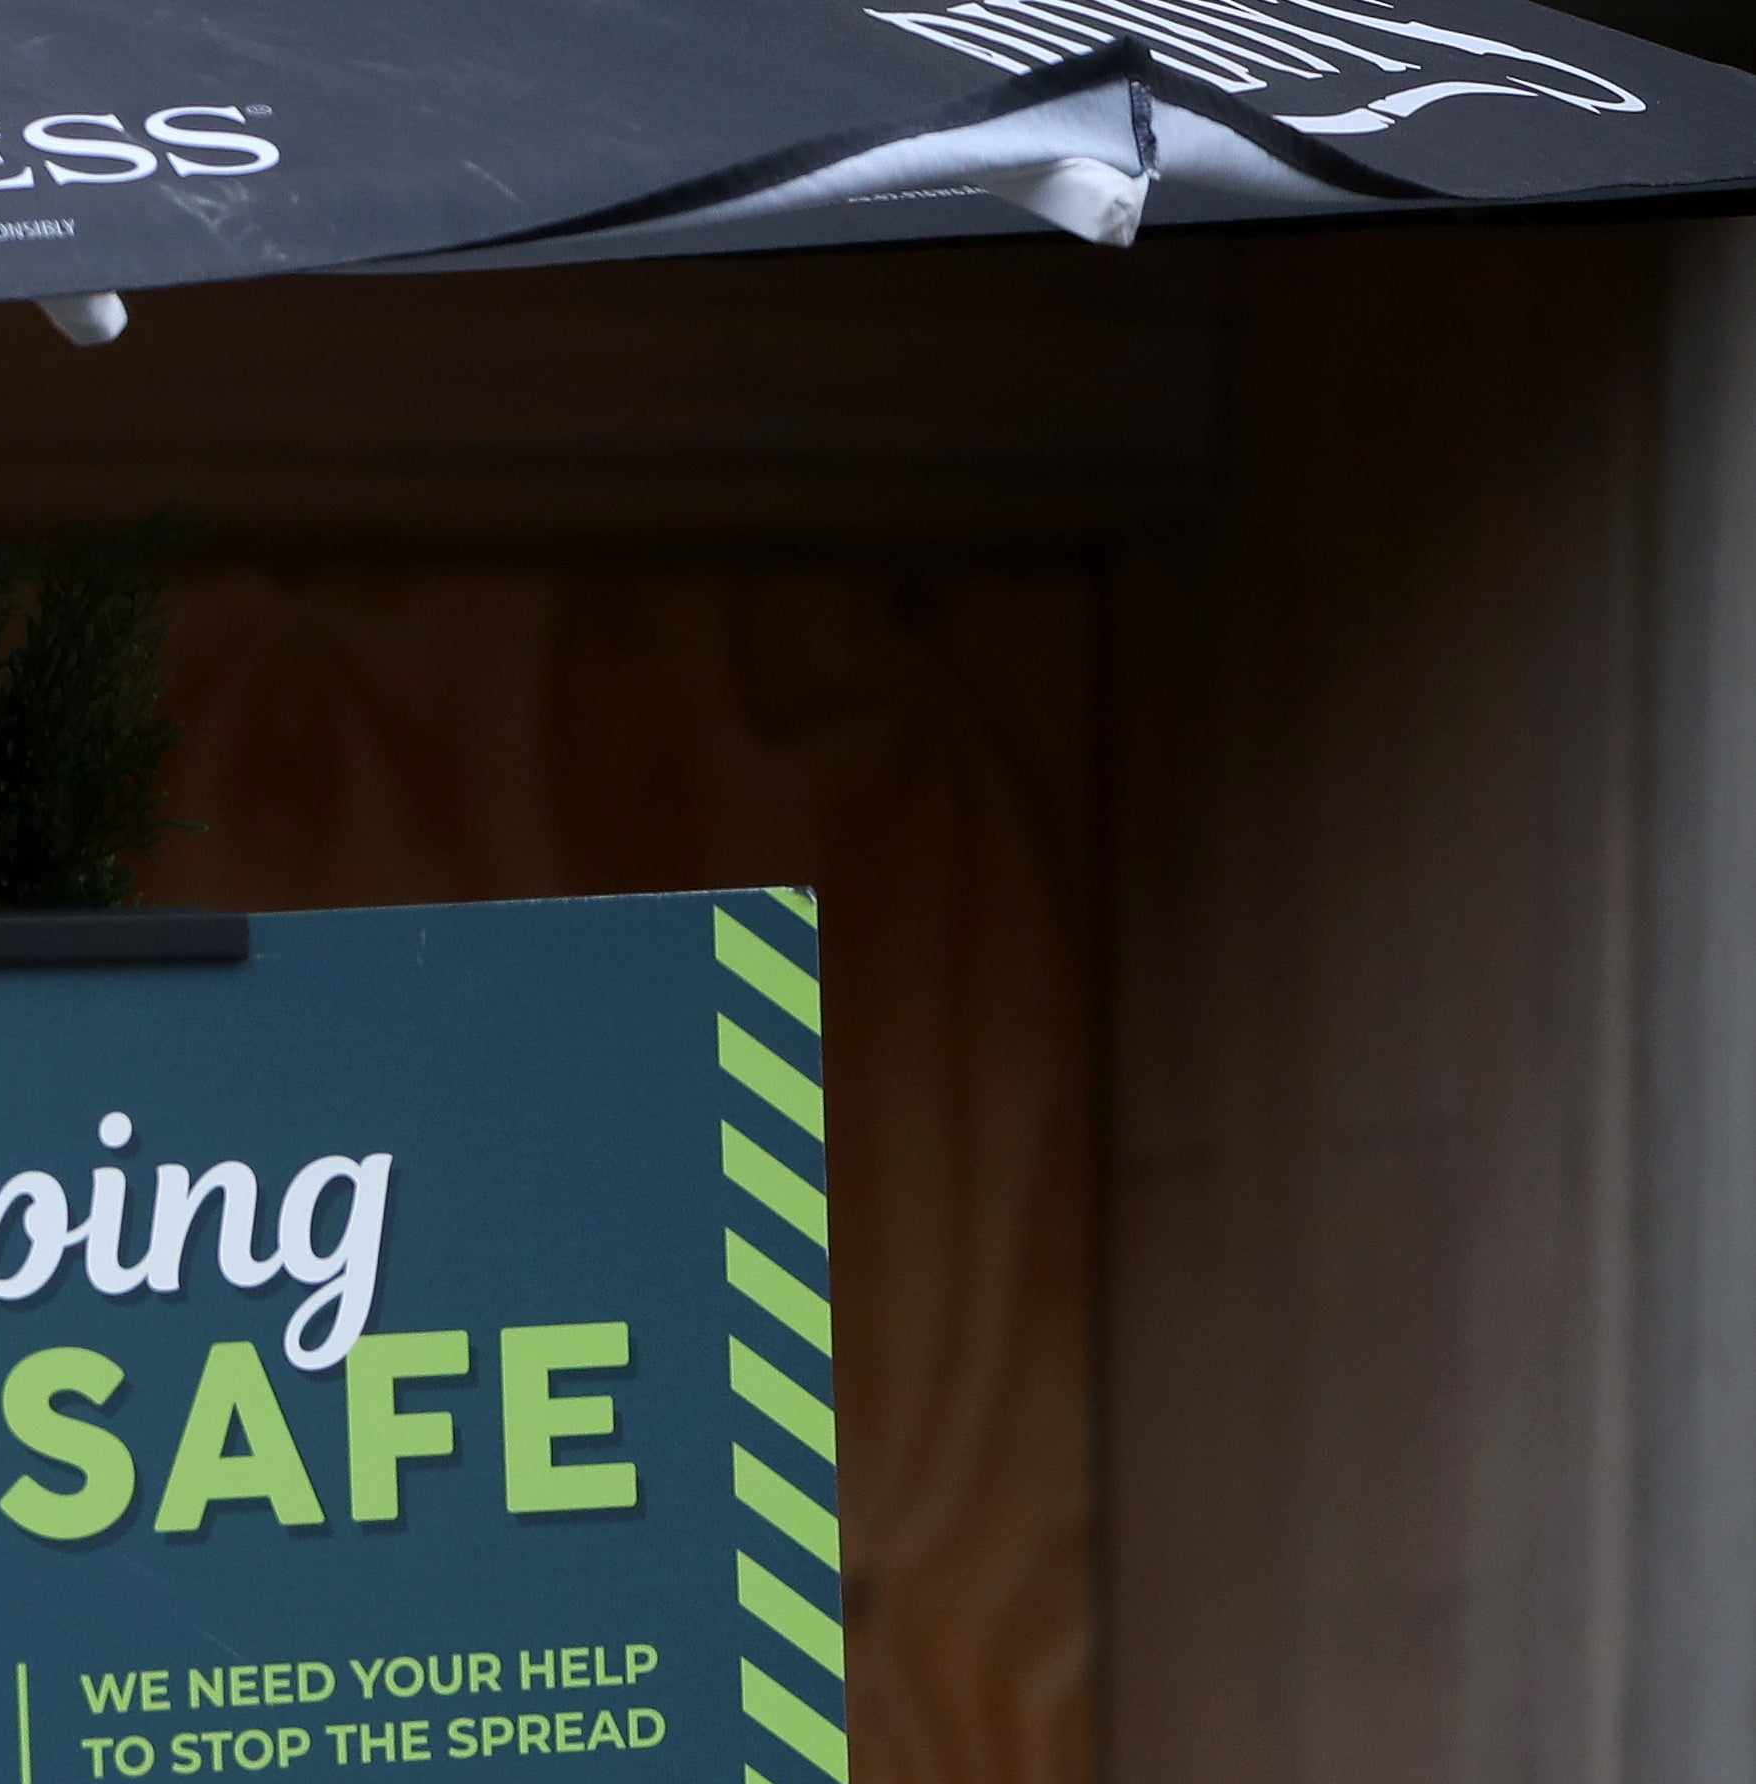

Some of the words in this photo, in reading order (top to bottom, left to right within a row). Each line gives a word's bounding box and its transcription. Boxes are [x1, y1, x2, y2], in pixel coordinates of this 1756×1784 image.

[0, 1321, 638, 1540] SAFE
[80, 1669, 171, 1715] WE
[188, 1661, 336, 1709] NEED
[349, 1652, 502, 1700] YOUR
[519, 1643, 659, 1691] HELP
[80, 1734, 155, 1779] TO
[170, 1727, 311, 1775] STOP
[324, 1719, 432, 1766] THE
[447, 1707, 666, 1759] SPREAD
